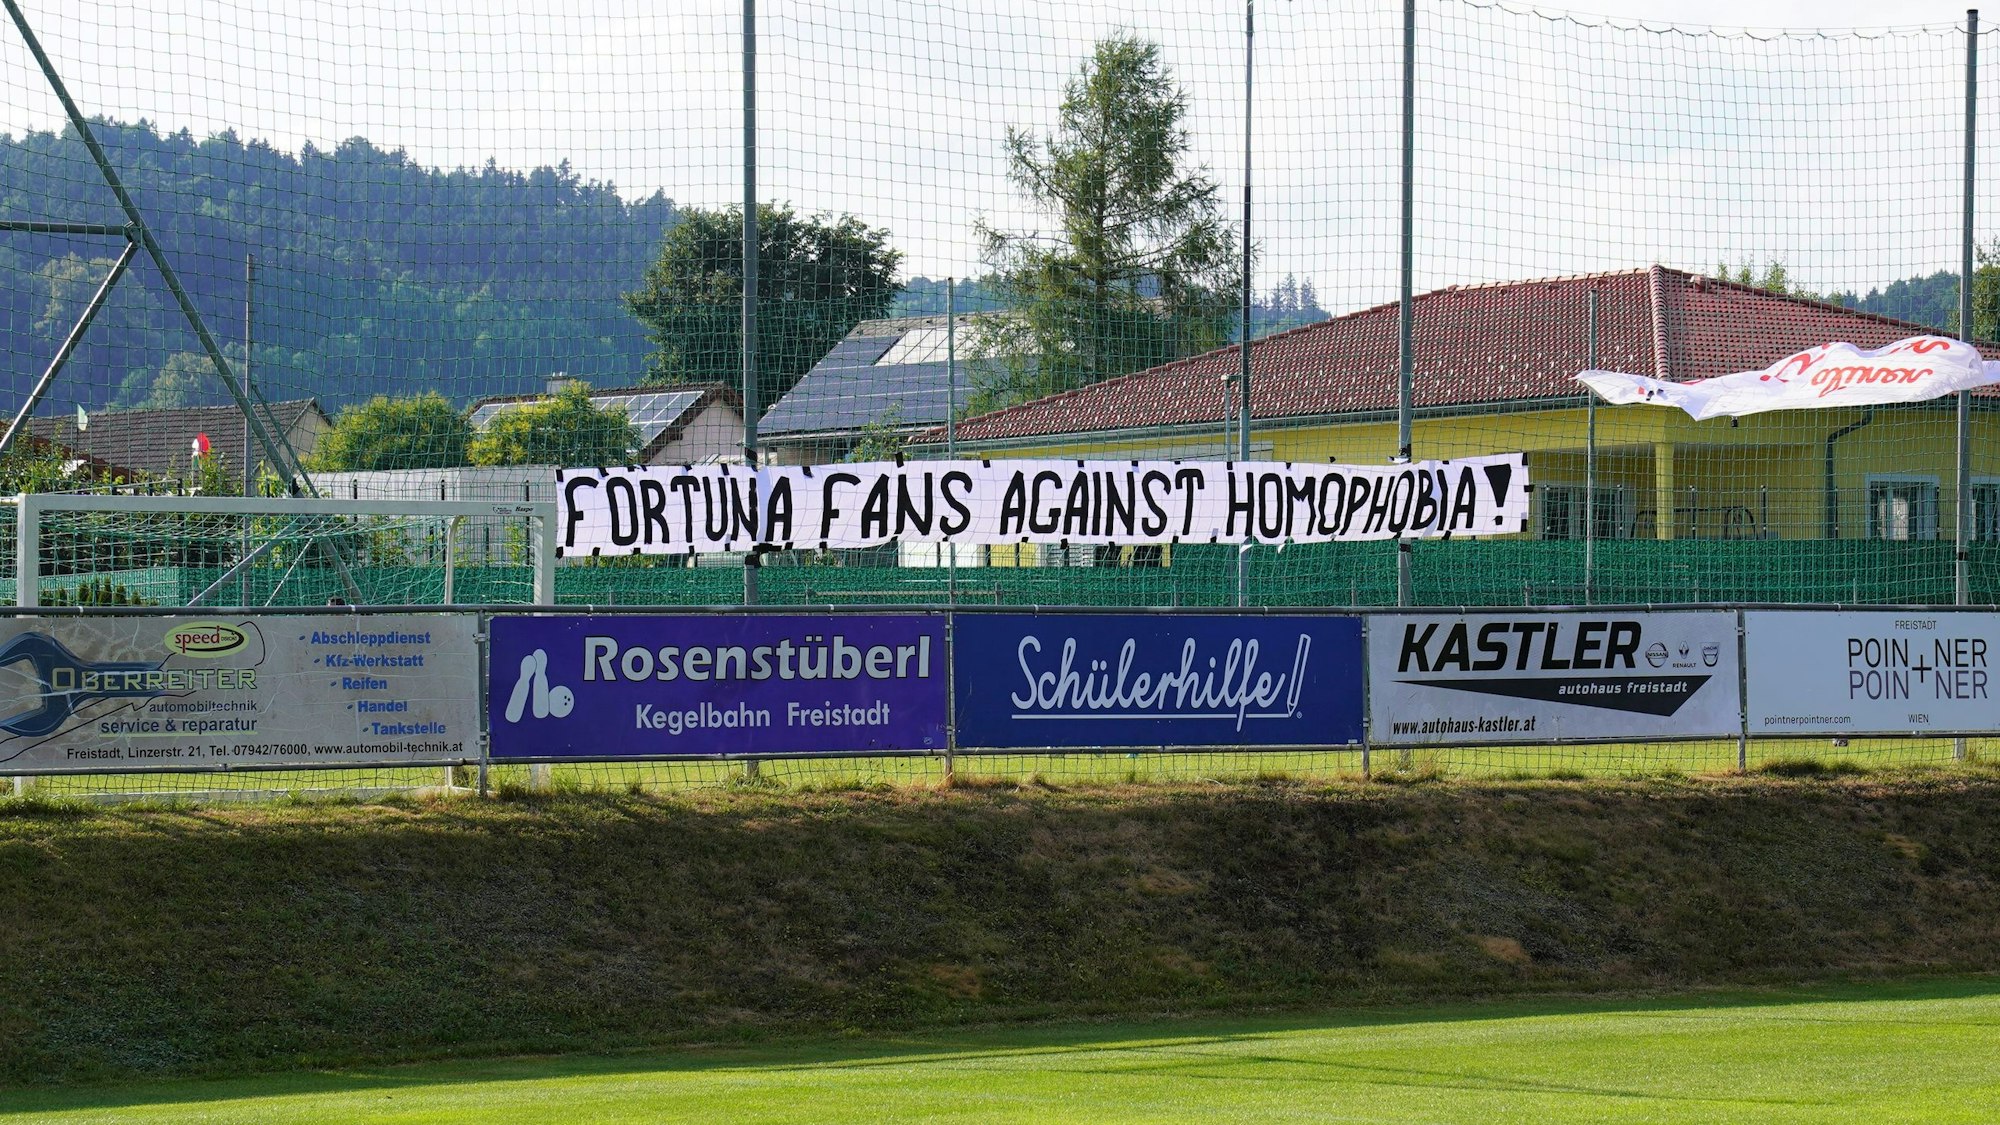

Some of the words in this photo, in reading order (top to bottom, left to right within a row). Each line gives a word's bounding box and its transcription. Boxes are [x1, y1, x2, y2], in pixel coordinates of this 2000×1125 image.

[565, 476, 792, 547] FORTUNA
[820, 471, 972, 540] FANS
[1000, 468, 1205, 537] AGAINST
[1226, 463, 1512, 539] HOMOPHOBIA!
[1895, 620, 1937, 630] FREISTADT
[175, 625, 220, 653] speed
[311, 631, 431, 647] Abschleppdienst
[1397, 621, 1642, 673] KASTLER
[325, 654, 424, 668] Kfz-Werkstatt
[583, 635, 931, 682] Rosenstüberl
[52, 667, 257, 691] OBERREITER
[342, 677, 387, 690] Reifen
[1558, 681, 1622, 695] autohaus
[1626, 680, 1688, 695] freistadt
[149, 700, 258, 713] automobiltechnik
[358, 701, 408, 713] Handel
[635, 702, 771, 736] Kegelbahn
[787, 700, 890, 728] Freistadt
[1393, 715, 1536, 735] www.autohaus-kastler.at
[1764, 714, 1851, 726] pointnerpointner.com
[1908, 713, 1929, 723] WIEN
[101, 719, 159, 734] service
[165, 719, 177, 732] &
[182, 718, 258, 735] reparatur
[371, 722, 447, 735] Tankstelle
[67, 748, 124, 760] Freistadt,
[128, 746, 184, 759] Linzerstr.
[188, 746, 205, 759] 21,
[210, 745, 229, 757] Tel.
[233, 743, 311, 757] 07942/76000,
[314, 740, 463, 754] www.automobil-technik.at
